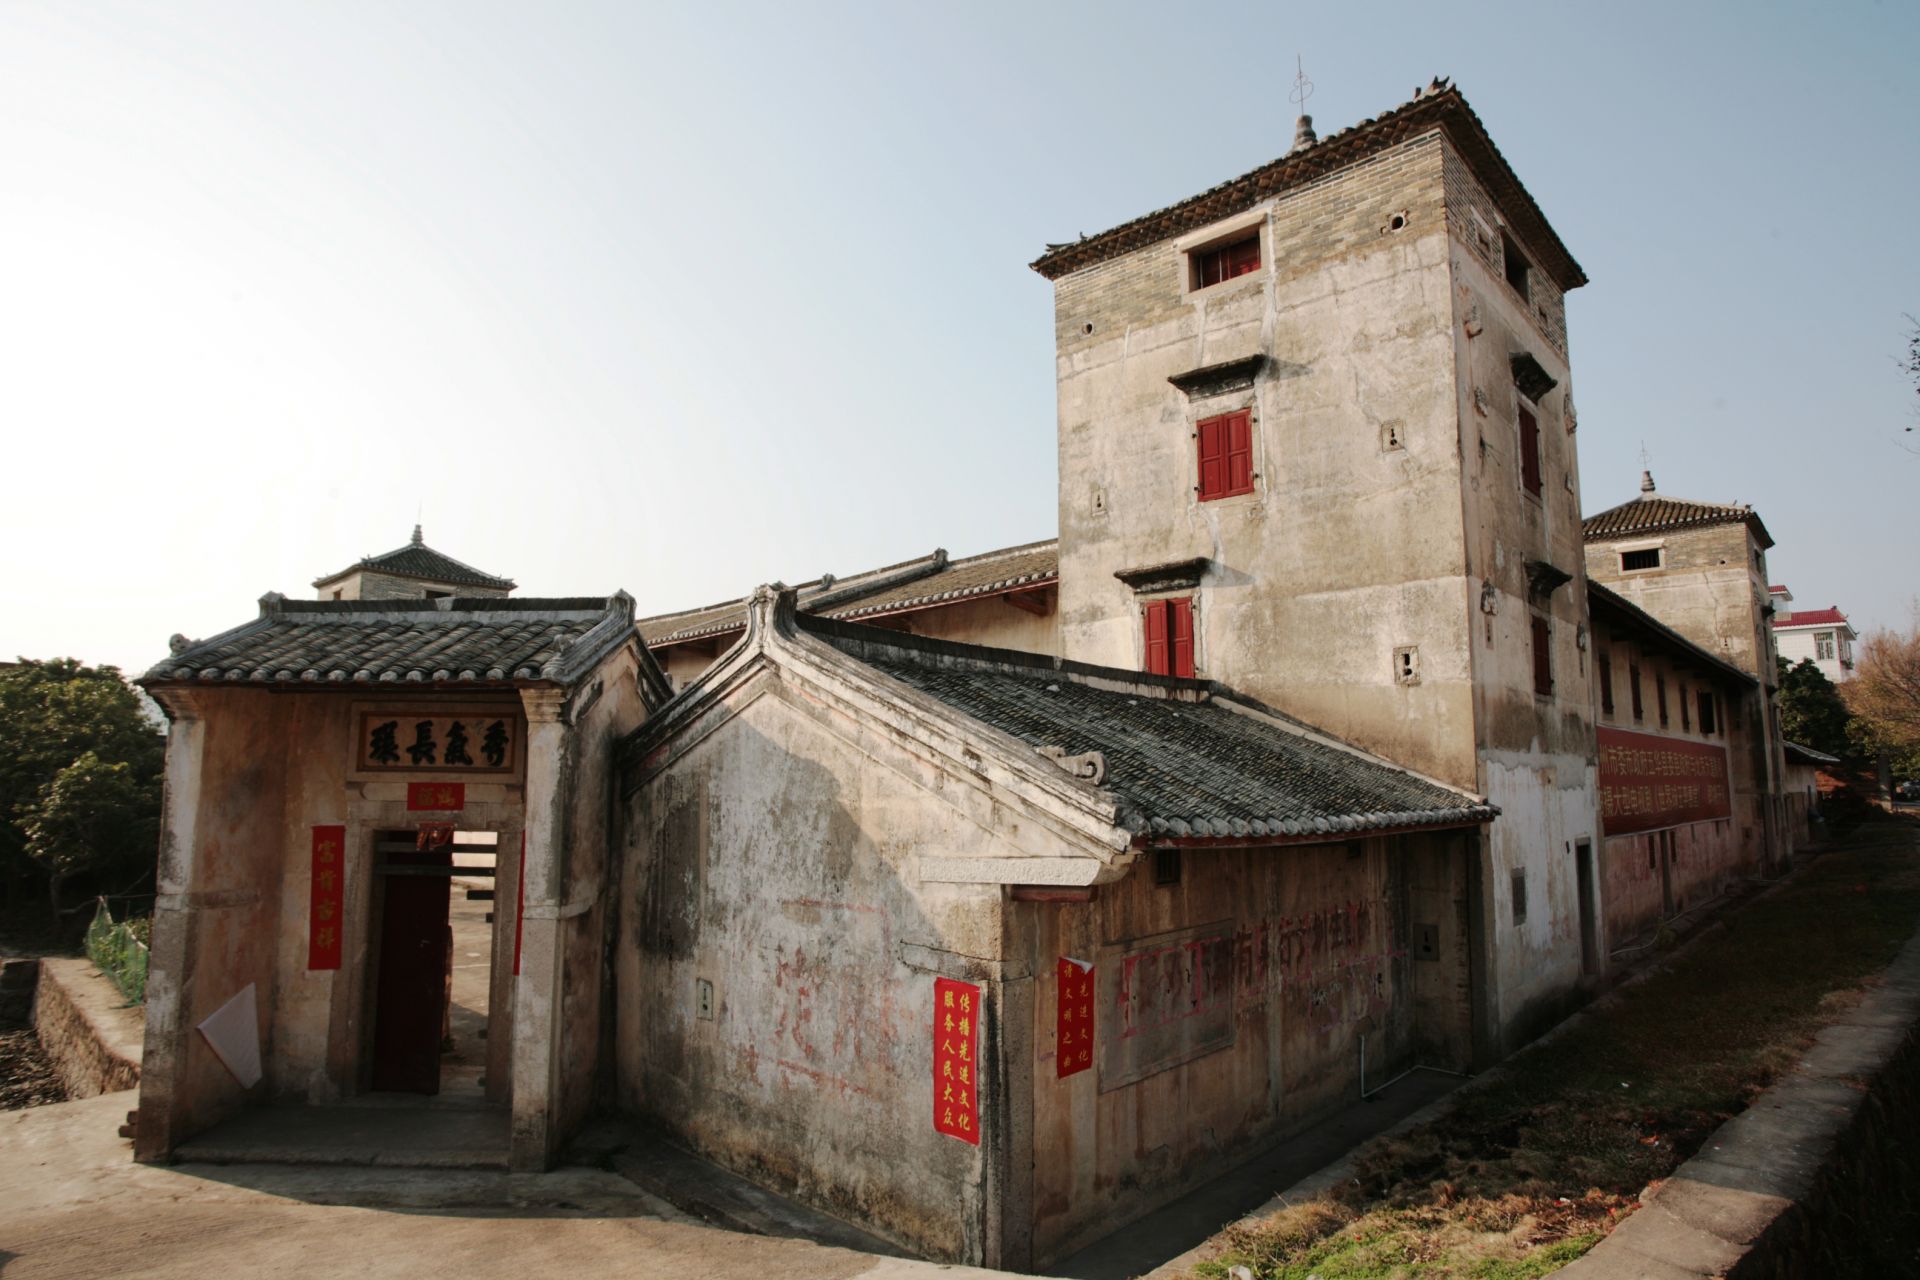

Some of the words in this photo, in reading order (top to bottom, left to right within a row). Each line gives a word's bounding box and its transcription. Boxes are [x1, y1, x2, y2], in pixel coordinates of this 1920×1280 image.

[942, 990, 955, 1127] 服务人民大众
[958, 992, 971, 1132] 传播先进文化
[1078, 970, 1089, 1062] 先进文化
